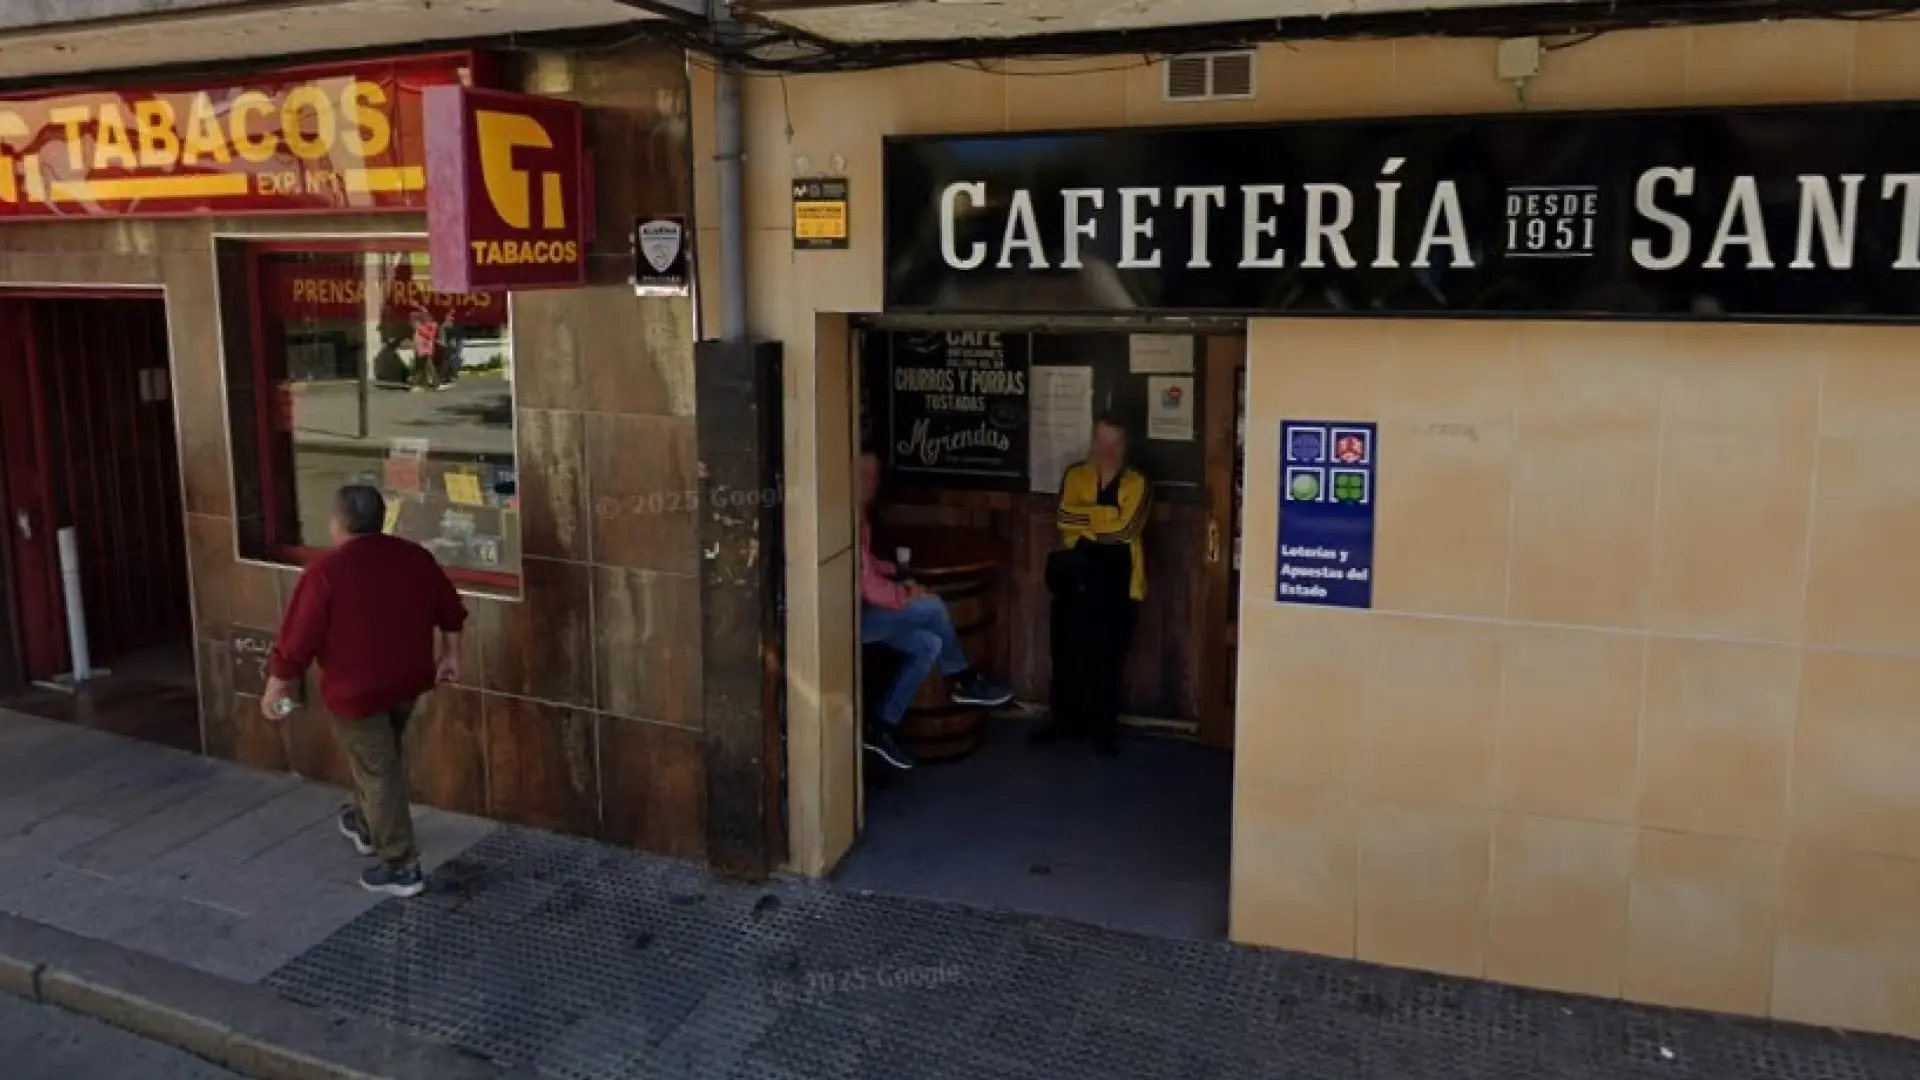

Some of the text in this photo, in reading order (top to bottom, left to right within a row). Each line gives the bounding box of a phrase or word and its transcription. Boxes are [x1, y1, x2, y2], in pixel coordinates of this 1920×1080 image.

[49, 81, 391, 170] TABACOS
[939, 157, 1476, 270] CAFETERÍA
[1506, 194, 1597, 216] DESDE
[1506, 217, 1595, 250] 1951
[471, 240, 577, 264] TABACOS
[293, 278, 368, 304] PRENSA
[894, 366, 1025, 395] CHURROS Y PORRAS
[924, 394, 986, 412] TOSTADAS
[1339, 550, 1349, 563] y
[1280, 563, 1368, 580] Apuestas del
[1279, 581, 1328, 598] Estado
